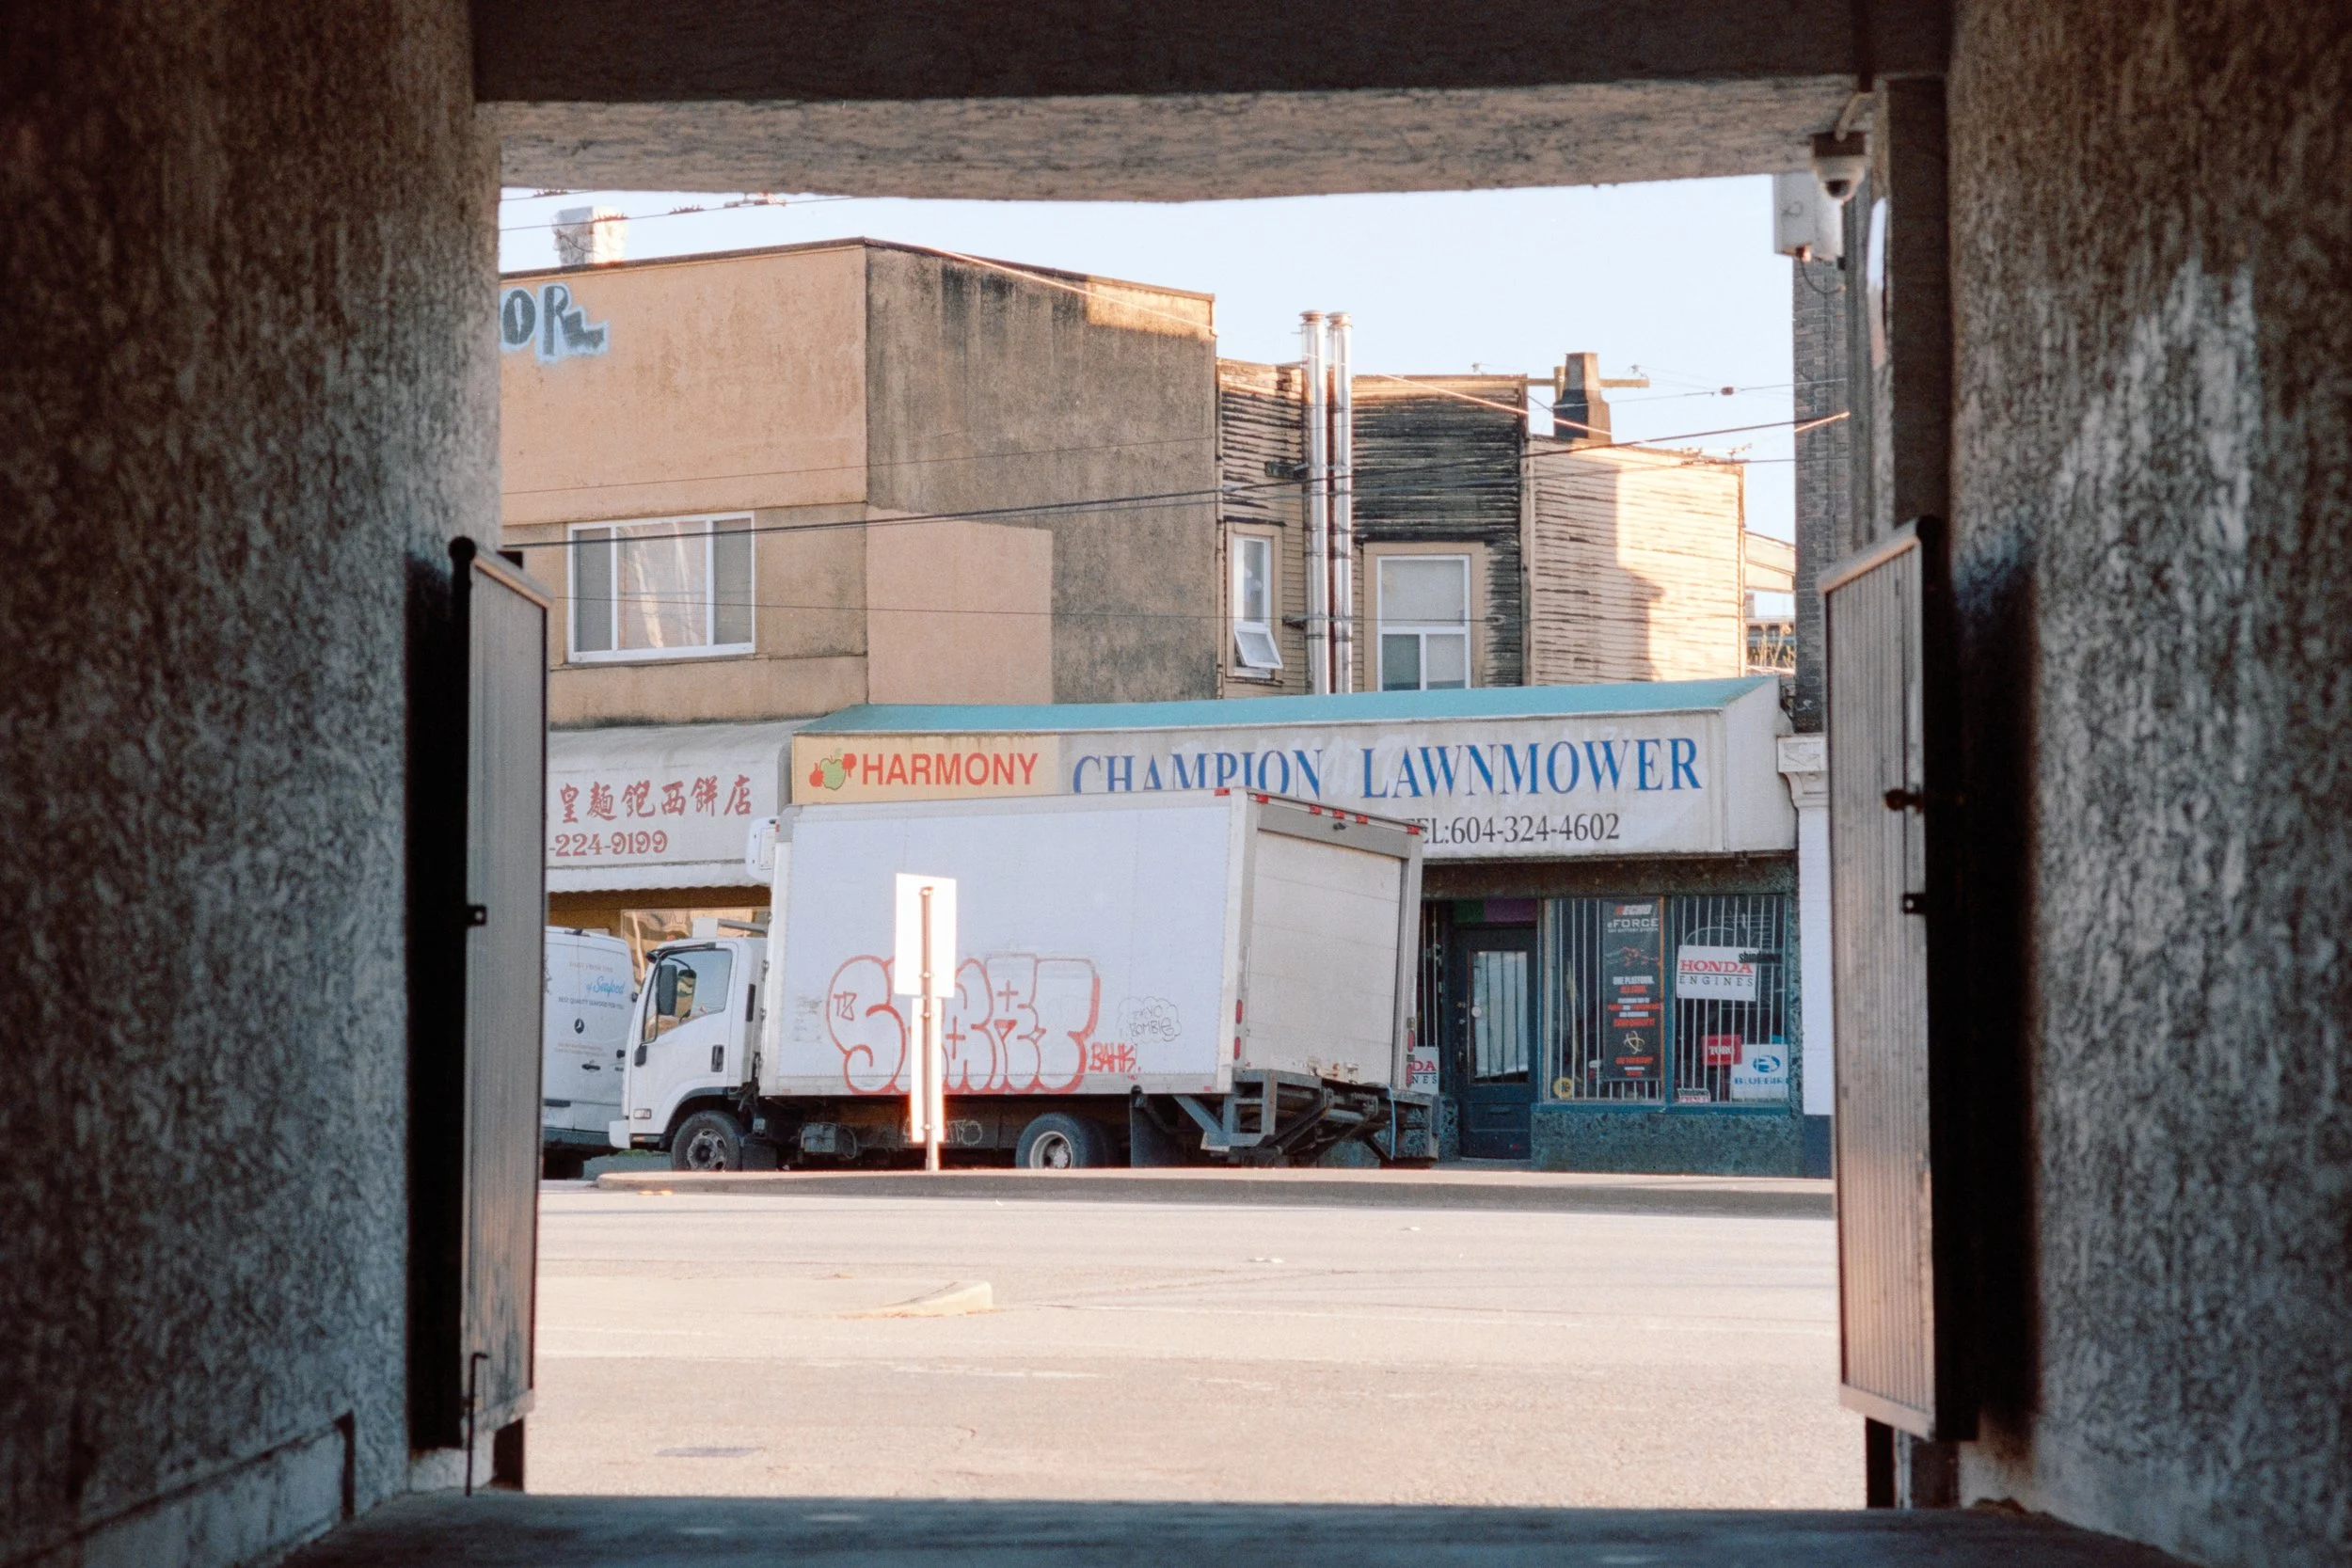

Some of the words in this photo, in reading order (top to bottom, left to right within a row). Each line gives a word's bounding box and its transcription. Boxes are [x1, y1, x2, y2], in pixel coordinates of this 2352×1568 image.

[862, 752, 1040, 785] HARMONY
[1072, 749, 1322, 800] CHAMPION
[1360, 736, 1703, 799] LAWNMOWER
[1406, 813, 1620, 844] EL:604-324-4602
[1607, 918, 1659, 928] eFORCE
[1679, 960, 1754, 974] HONDA
[1678, 975, 1754, 988] ENGINES
